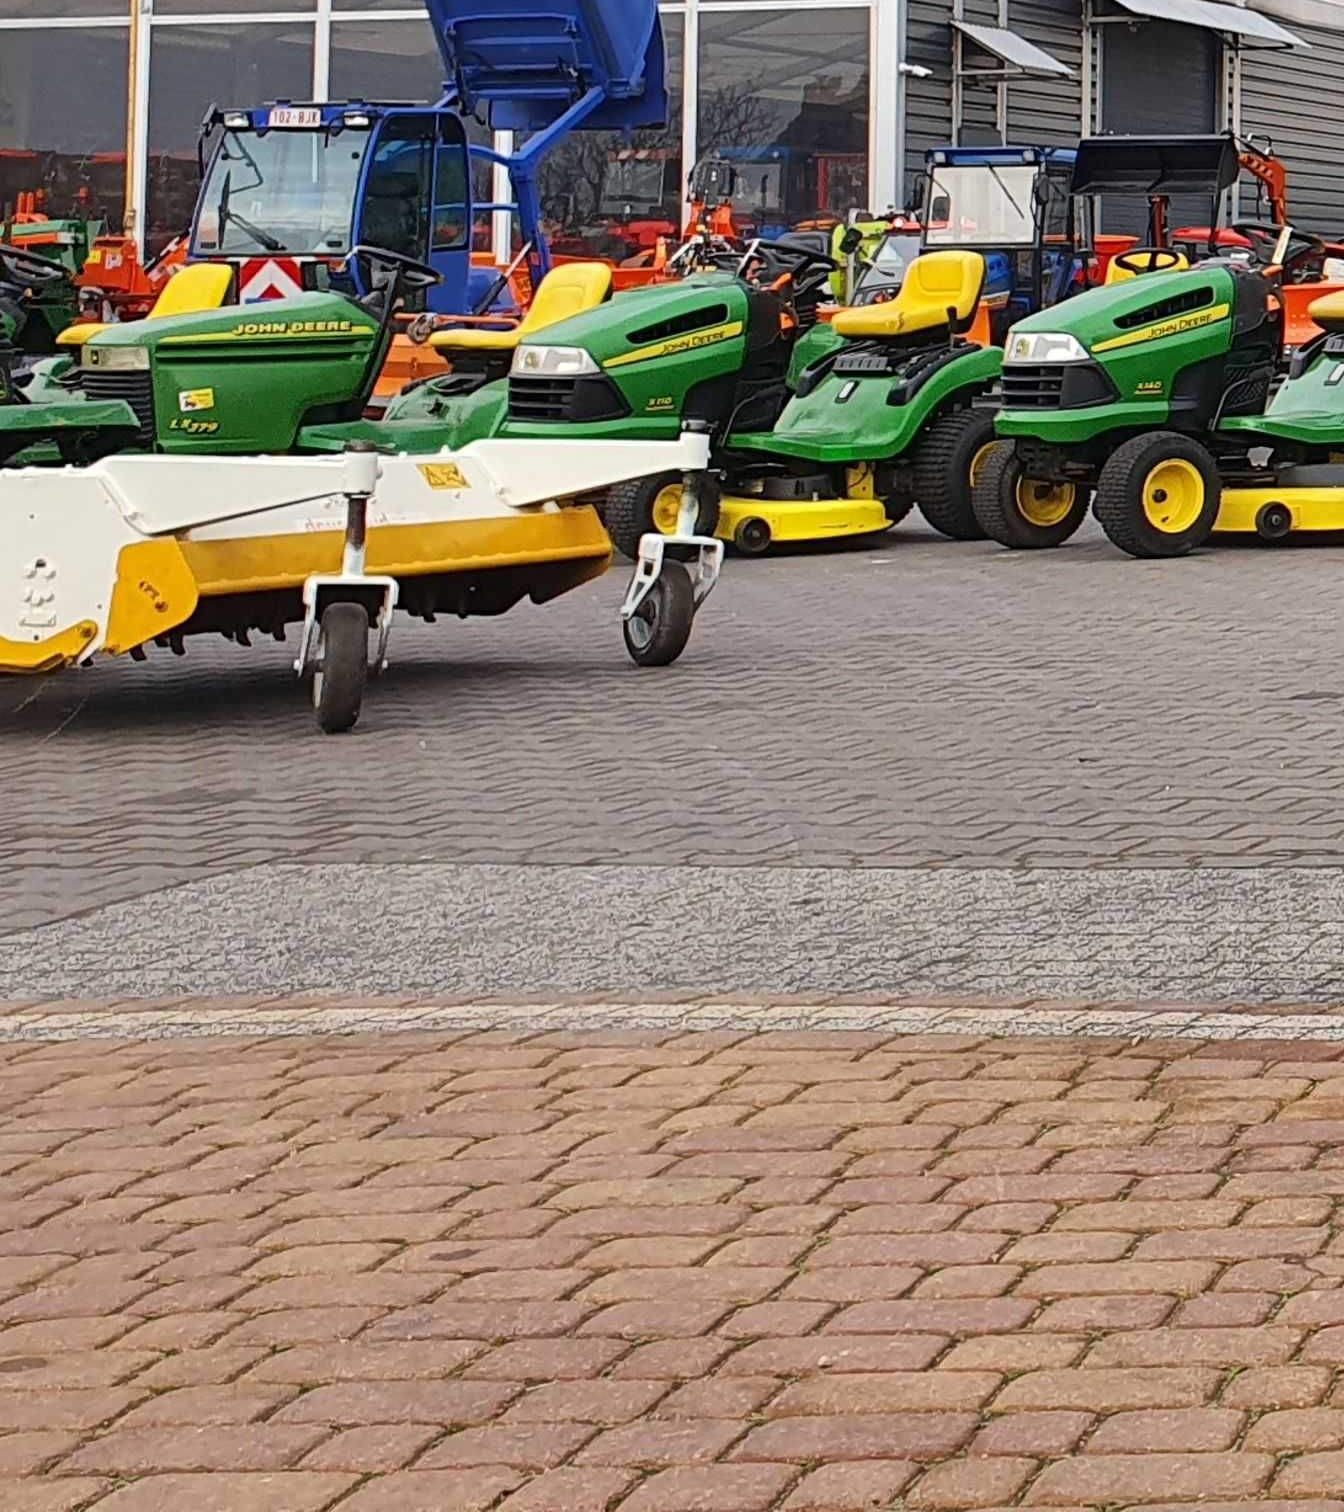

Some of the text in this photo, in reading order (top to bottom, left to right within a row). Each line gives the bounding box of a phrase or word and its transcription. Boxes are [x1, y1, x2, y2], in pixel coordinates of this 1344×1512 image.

[232, 320, 352, 336] JOHN DEERE
[1148, 313, 1212, 338] JOHN DEERE
